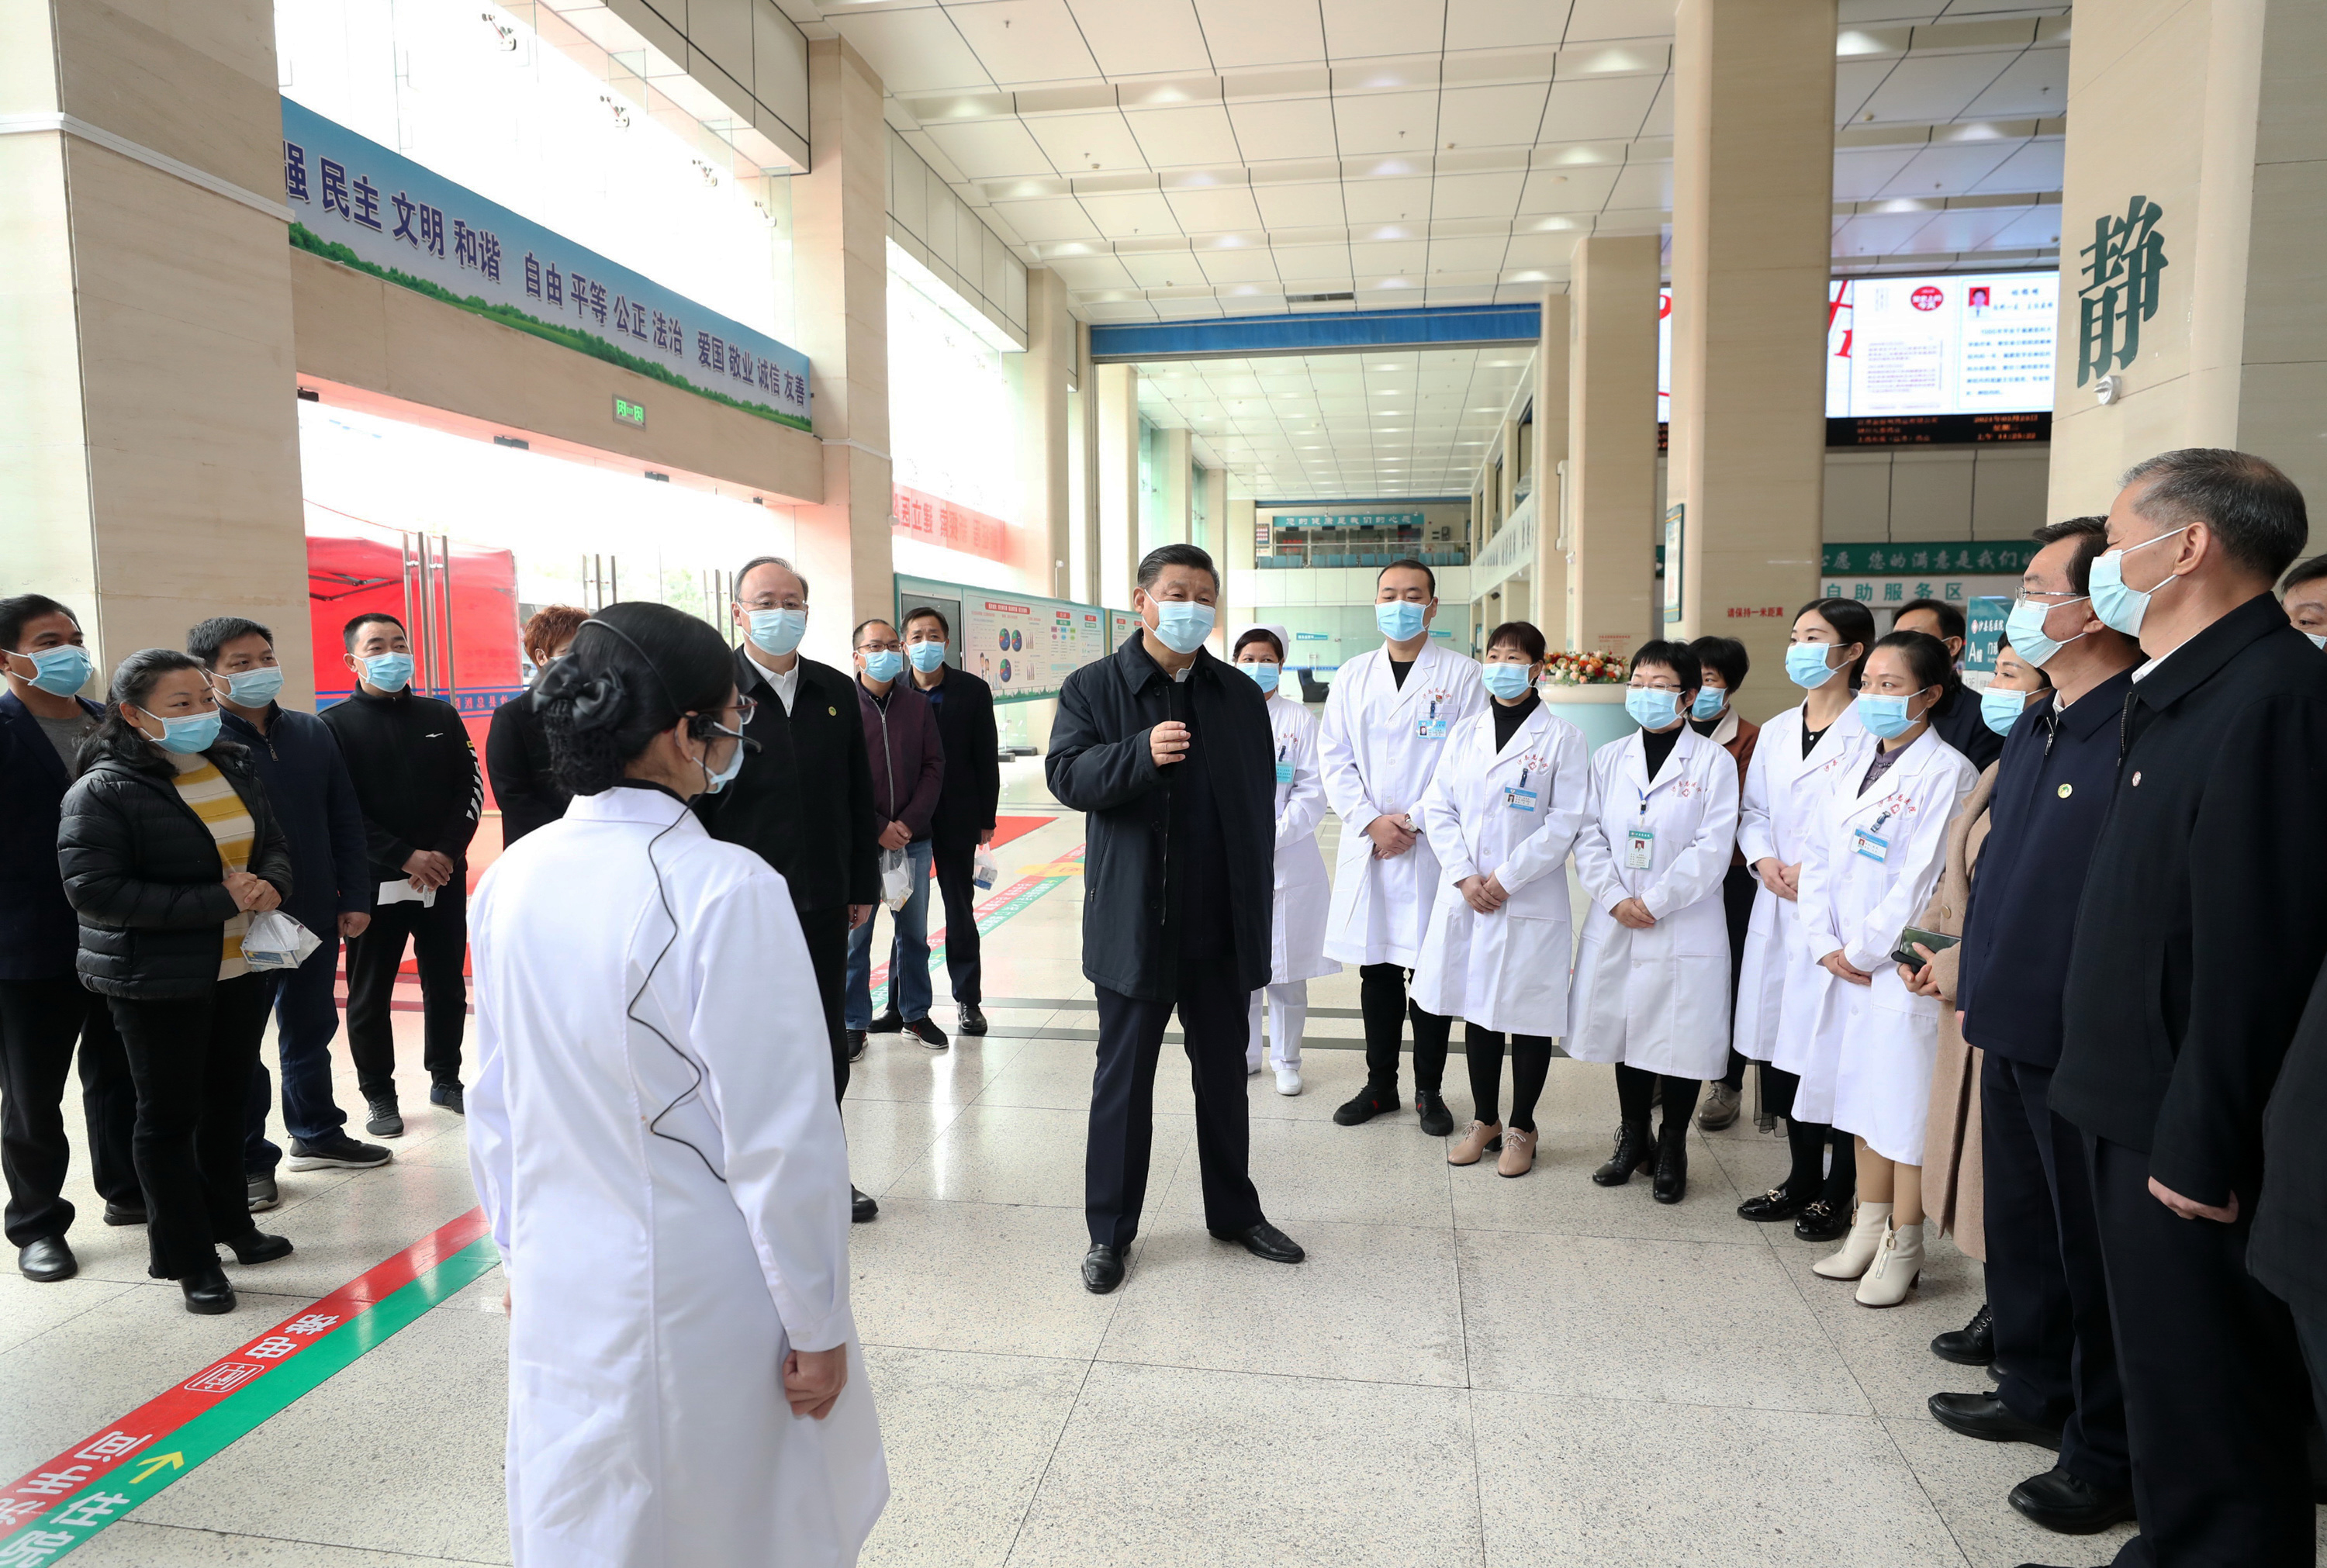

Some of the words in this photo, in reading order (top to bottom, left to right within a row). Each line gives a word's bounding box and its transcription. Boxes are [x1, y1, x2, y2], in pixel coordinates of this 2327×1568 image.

[283, 139, 310, 203] 强
[320, 155, 382, 232] 民主
[390, 190, 445, 258] 文明
[452, 218, 501, 284] 和谐
[524, 250, 564, 308] 自由
[570, 271, 608, 326] 平等
[613, 295, 648, 341] 公正
[652, 309, 683, 356] 法治
[697, 330, 725, 374] 爱国
[728, 343, 754, 385] 敬业
[757, 357, 781, 397] 诚信
[783, 369, 806, 408] 友善
[2076, 194, 2169, 388] 静
[1285, 515, 1412, 526] 您的健康是我们的心愿
[1827, 582, 1963, 601] 自助服务区
[1727, 606, 1783, 618] 请保持一米距离
[245, 1313, 340, 1359] 电梯
